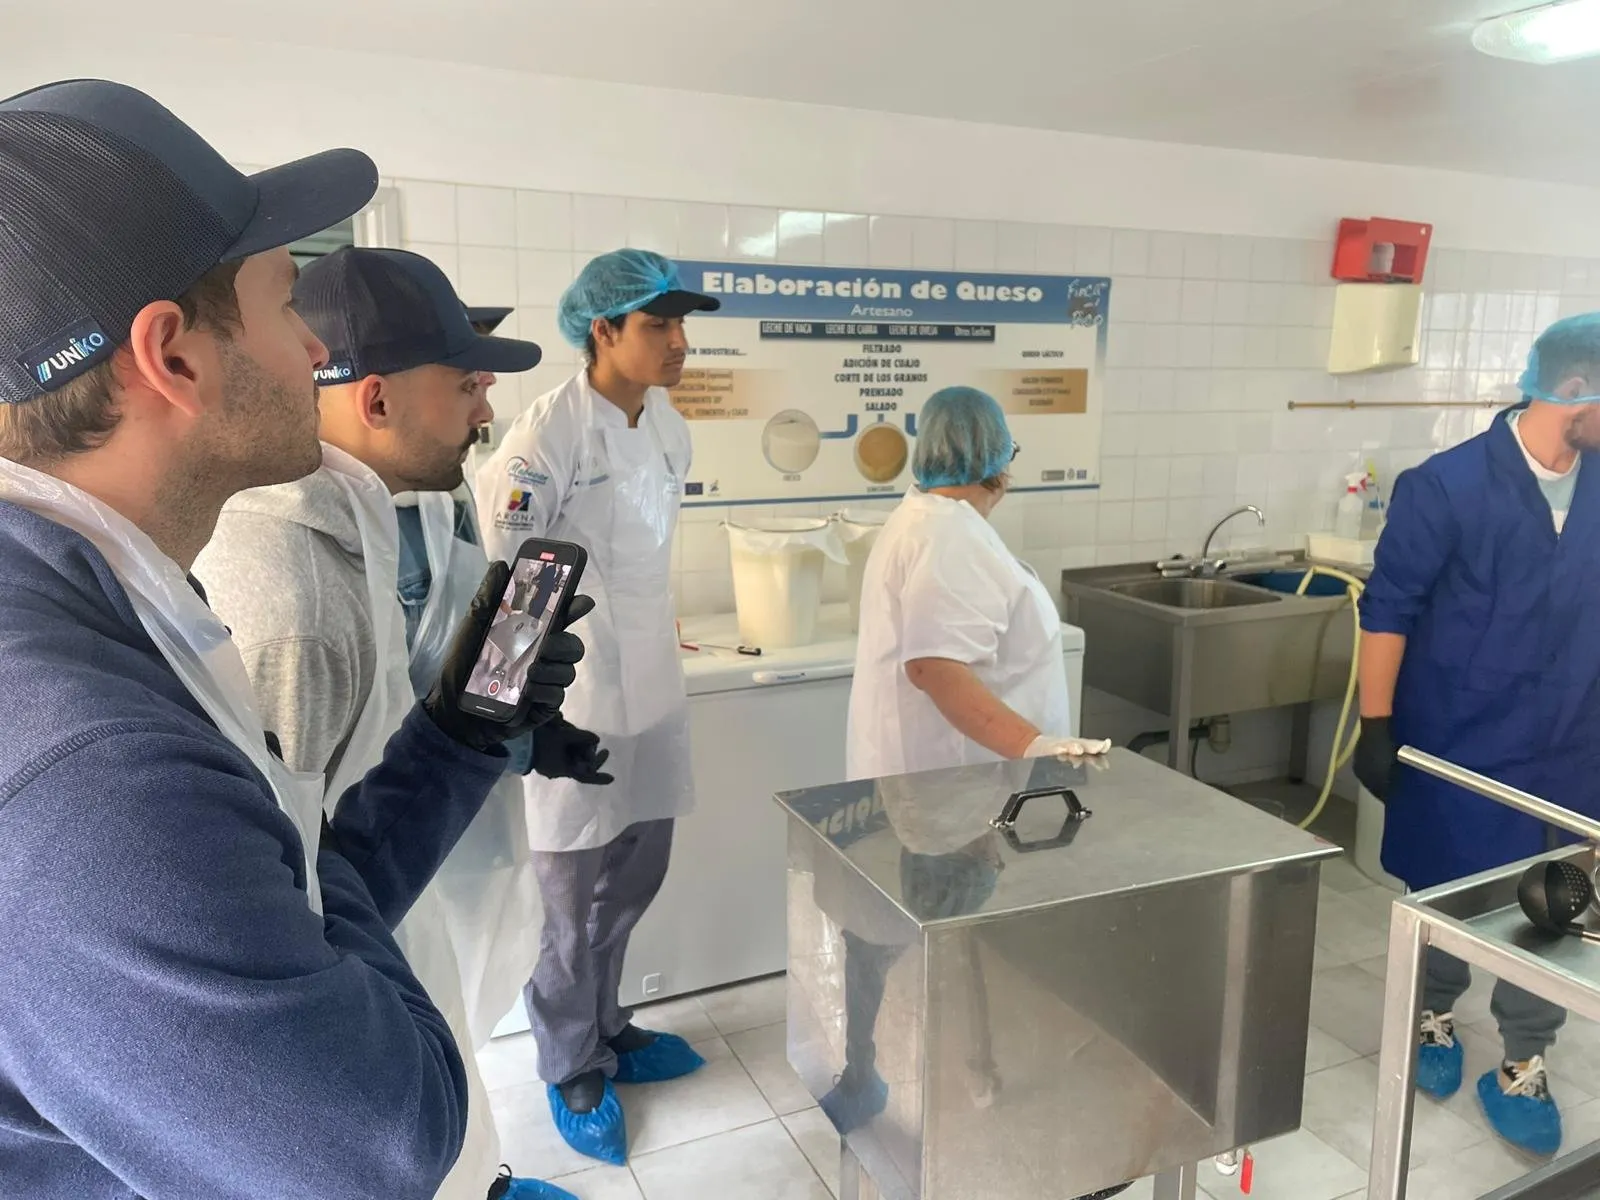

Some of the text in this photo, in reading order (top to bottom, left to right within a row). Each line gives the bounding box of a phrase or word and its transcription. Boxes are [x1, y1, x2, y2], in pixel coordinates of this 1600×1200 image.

[702, 271, 1043, 302] Elaboración de Queso
[851, 303, 914, 317] Artesano
[862, 344, 902, 353] FILTRADO
[843, 356, 920, 368] ADICIÓN DE CUAJO
[834, 373, 928, 383] CORTE DE LOS GRANOS
[859, 388, 904, 397] PRENSADO
[865, 402, 897, 411] SALADO
[496, 511, 536, 522] ARONA
